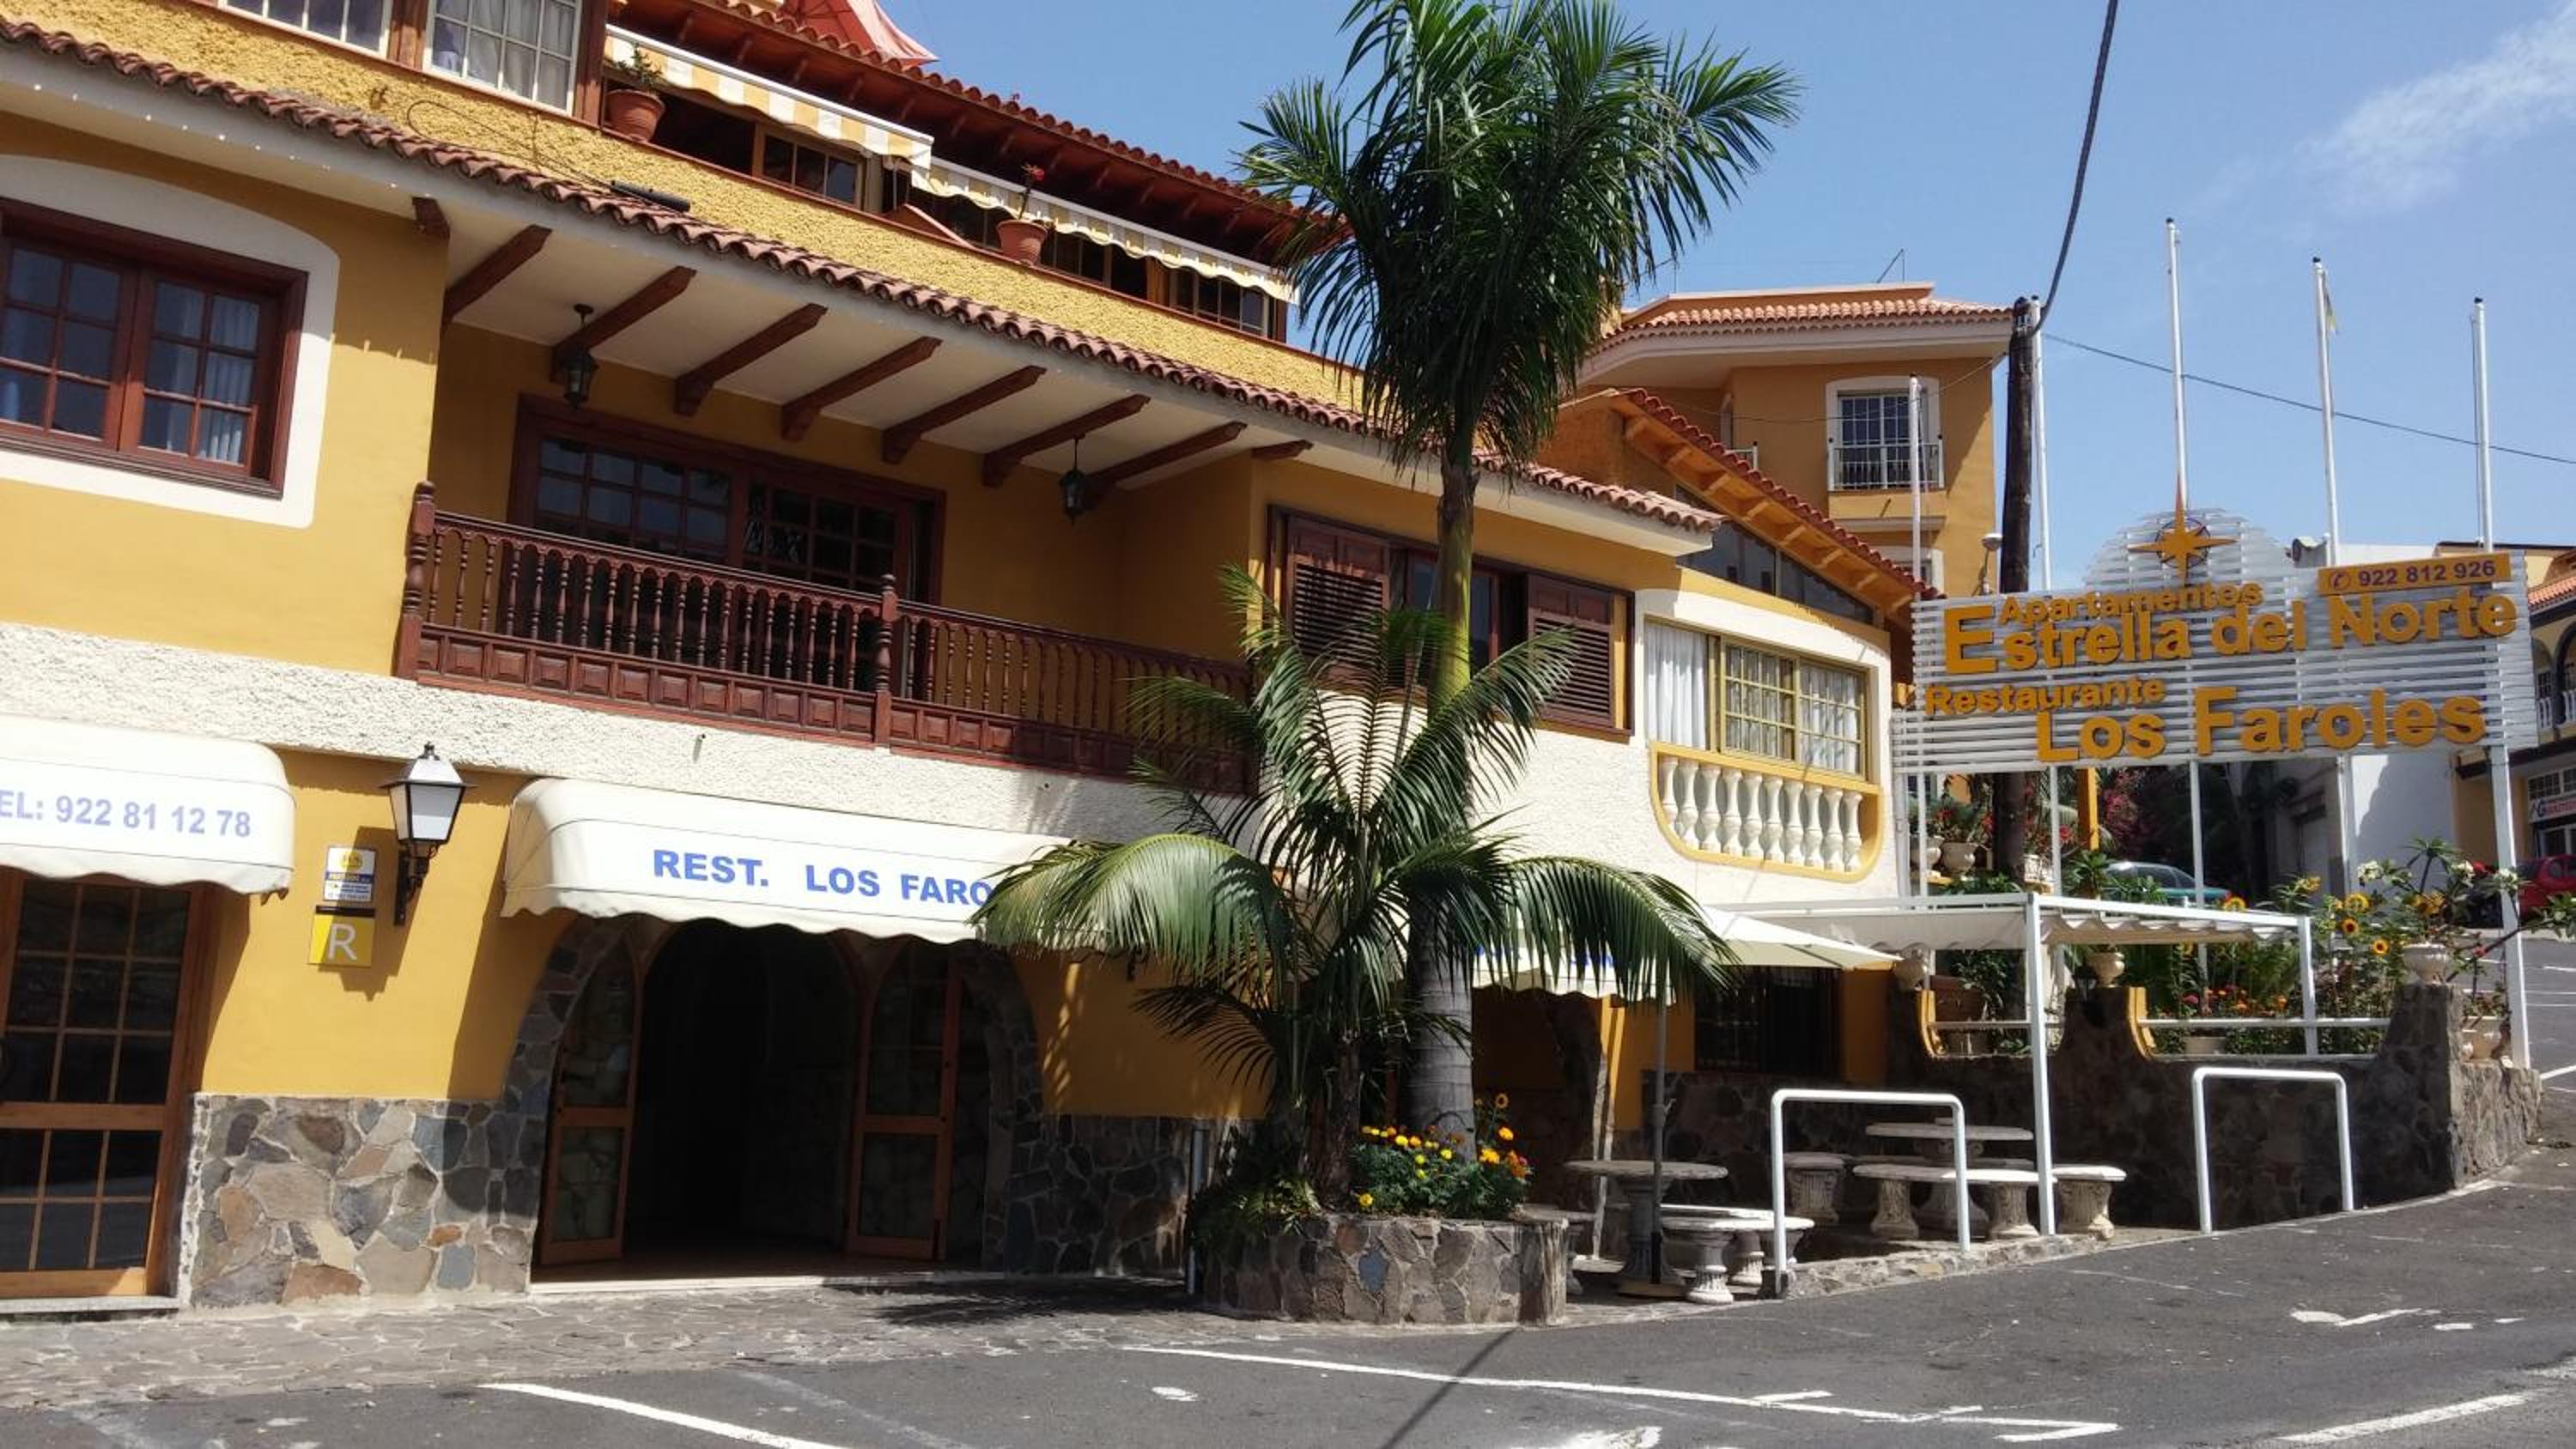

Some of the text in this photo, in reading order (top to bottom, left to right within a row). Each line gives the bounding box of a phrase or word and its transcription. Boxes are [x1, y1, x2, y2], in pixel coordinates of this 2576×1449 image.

[2358, 560, 2495, 586] 922 812 926
[1998, 581, 2264, 626] Apartamentos
[1944, 585, 2517, 676] Estrella del Norte
[1924, 674, 2168, 716] Restaurante
[2037, 687, 2488, 762] Los Faroles
[56, 795, 112, 826] 922
[123, 801, 157, 830] 81
[171, 805, 206, 835] 12
[216, 809, 252, 838] 78
[653, 849, 769, 888] REST.
[805, 864, 881, 897] LOS
[328, 922, 358, 961] R
